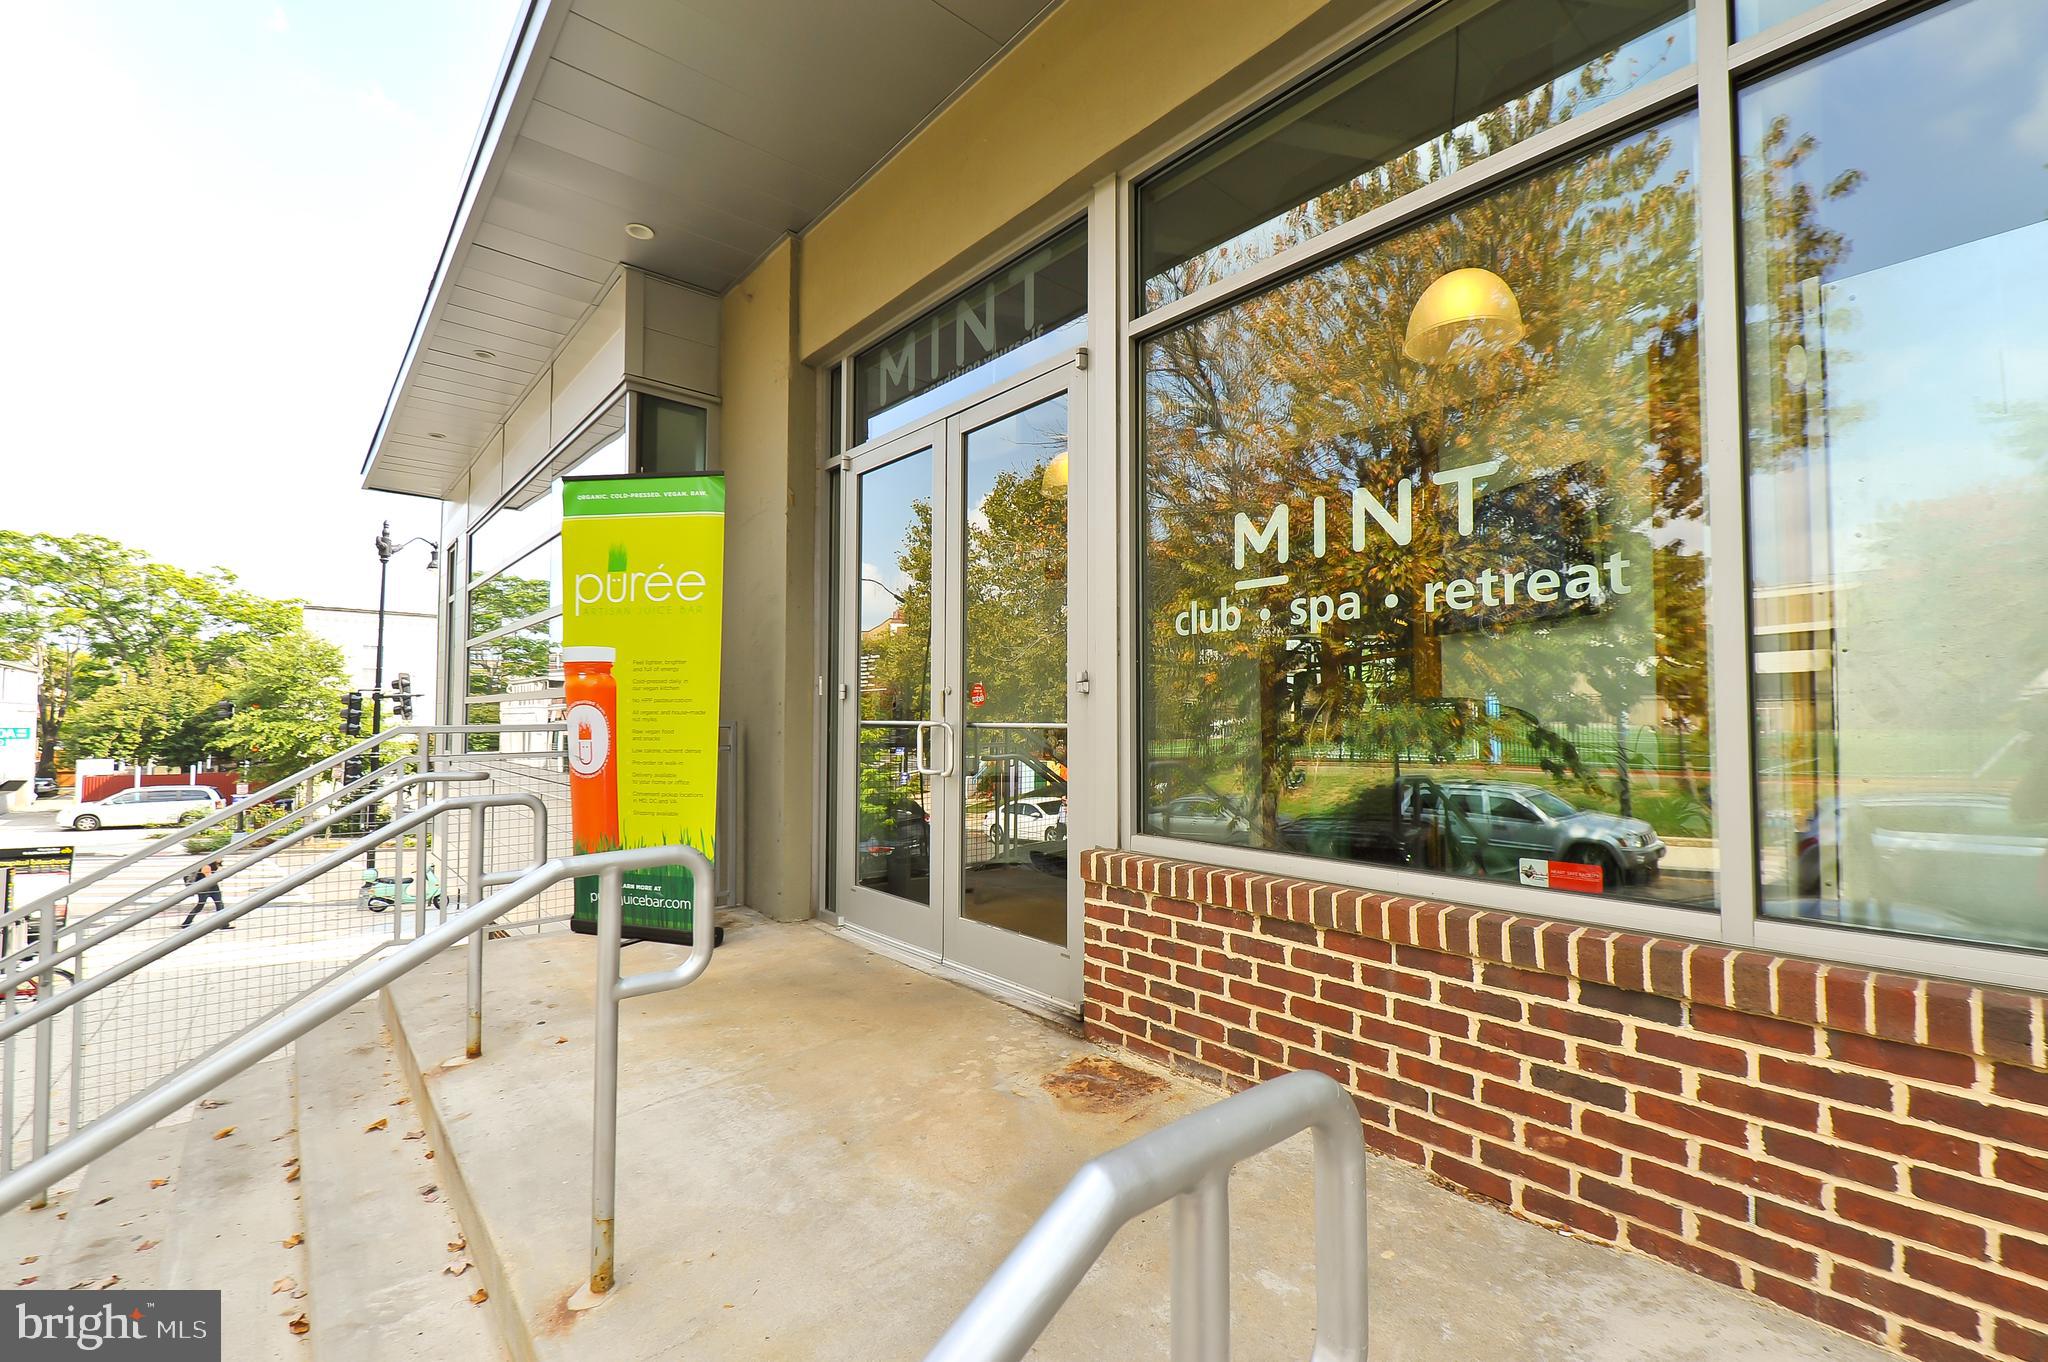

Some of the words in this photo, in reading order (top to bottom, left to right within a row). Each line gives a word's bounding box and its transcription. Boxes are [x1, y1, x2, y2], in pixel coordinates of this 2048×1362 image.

[880, 248, 1052, 407] MINT
[1234, 455, 1509, 570] MINT
[1174, 600, 1241, 637] club
[1290, 590, 1361, 634] spa
[1425, 552, 1633, 613] retreat
[590, 891, 692, 910] pjuicebar.com
